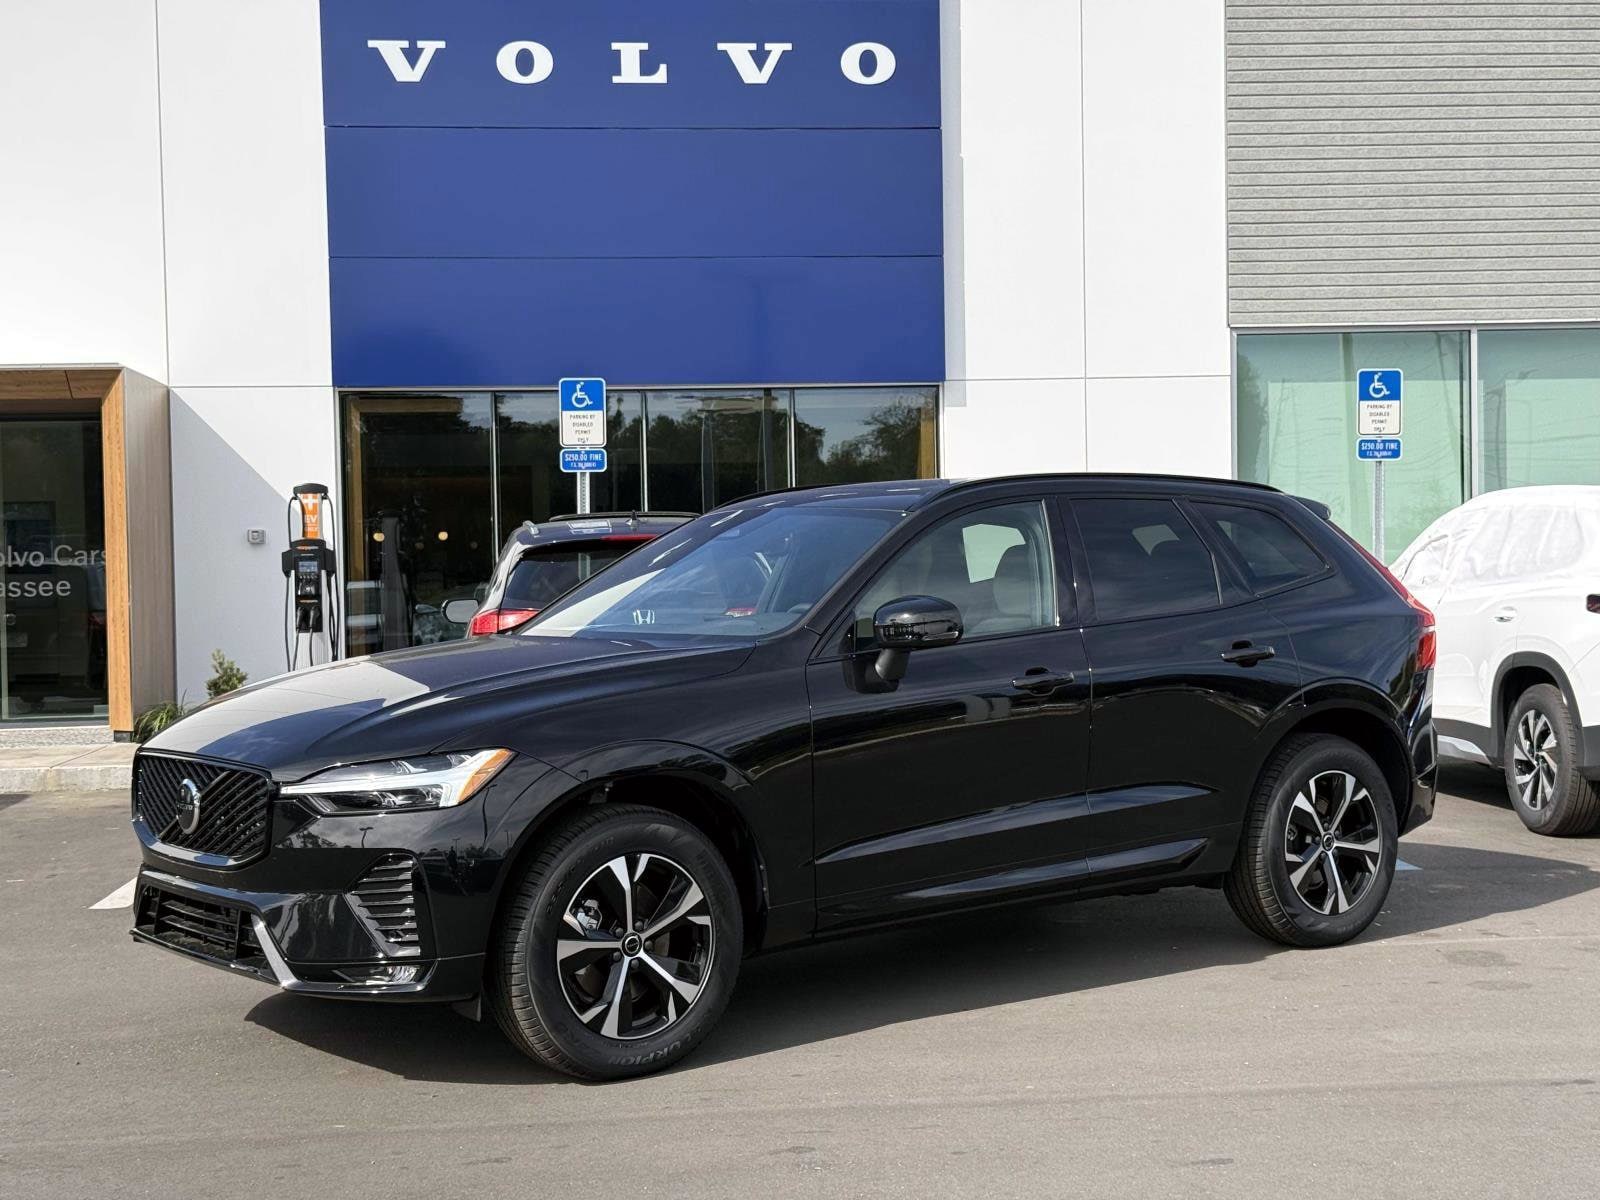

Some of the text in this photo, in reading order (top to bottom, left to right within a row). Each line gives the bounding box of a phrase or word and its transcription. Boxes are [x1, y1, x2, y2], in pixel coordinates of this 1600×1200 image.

[367, 40, 897, 85] VOLVO
[1361, 442, 1398, 450] $250.00 FINE
[565, 453, 602, 461] $250.00 FINE
